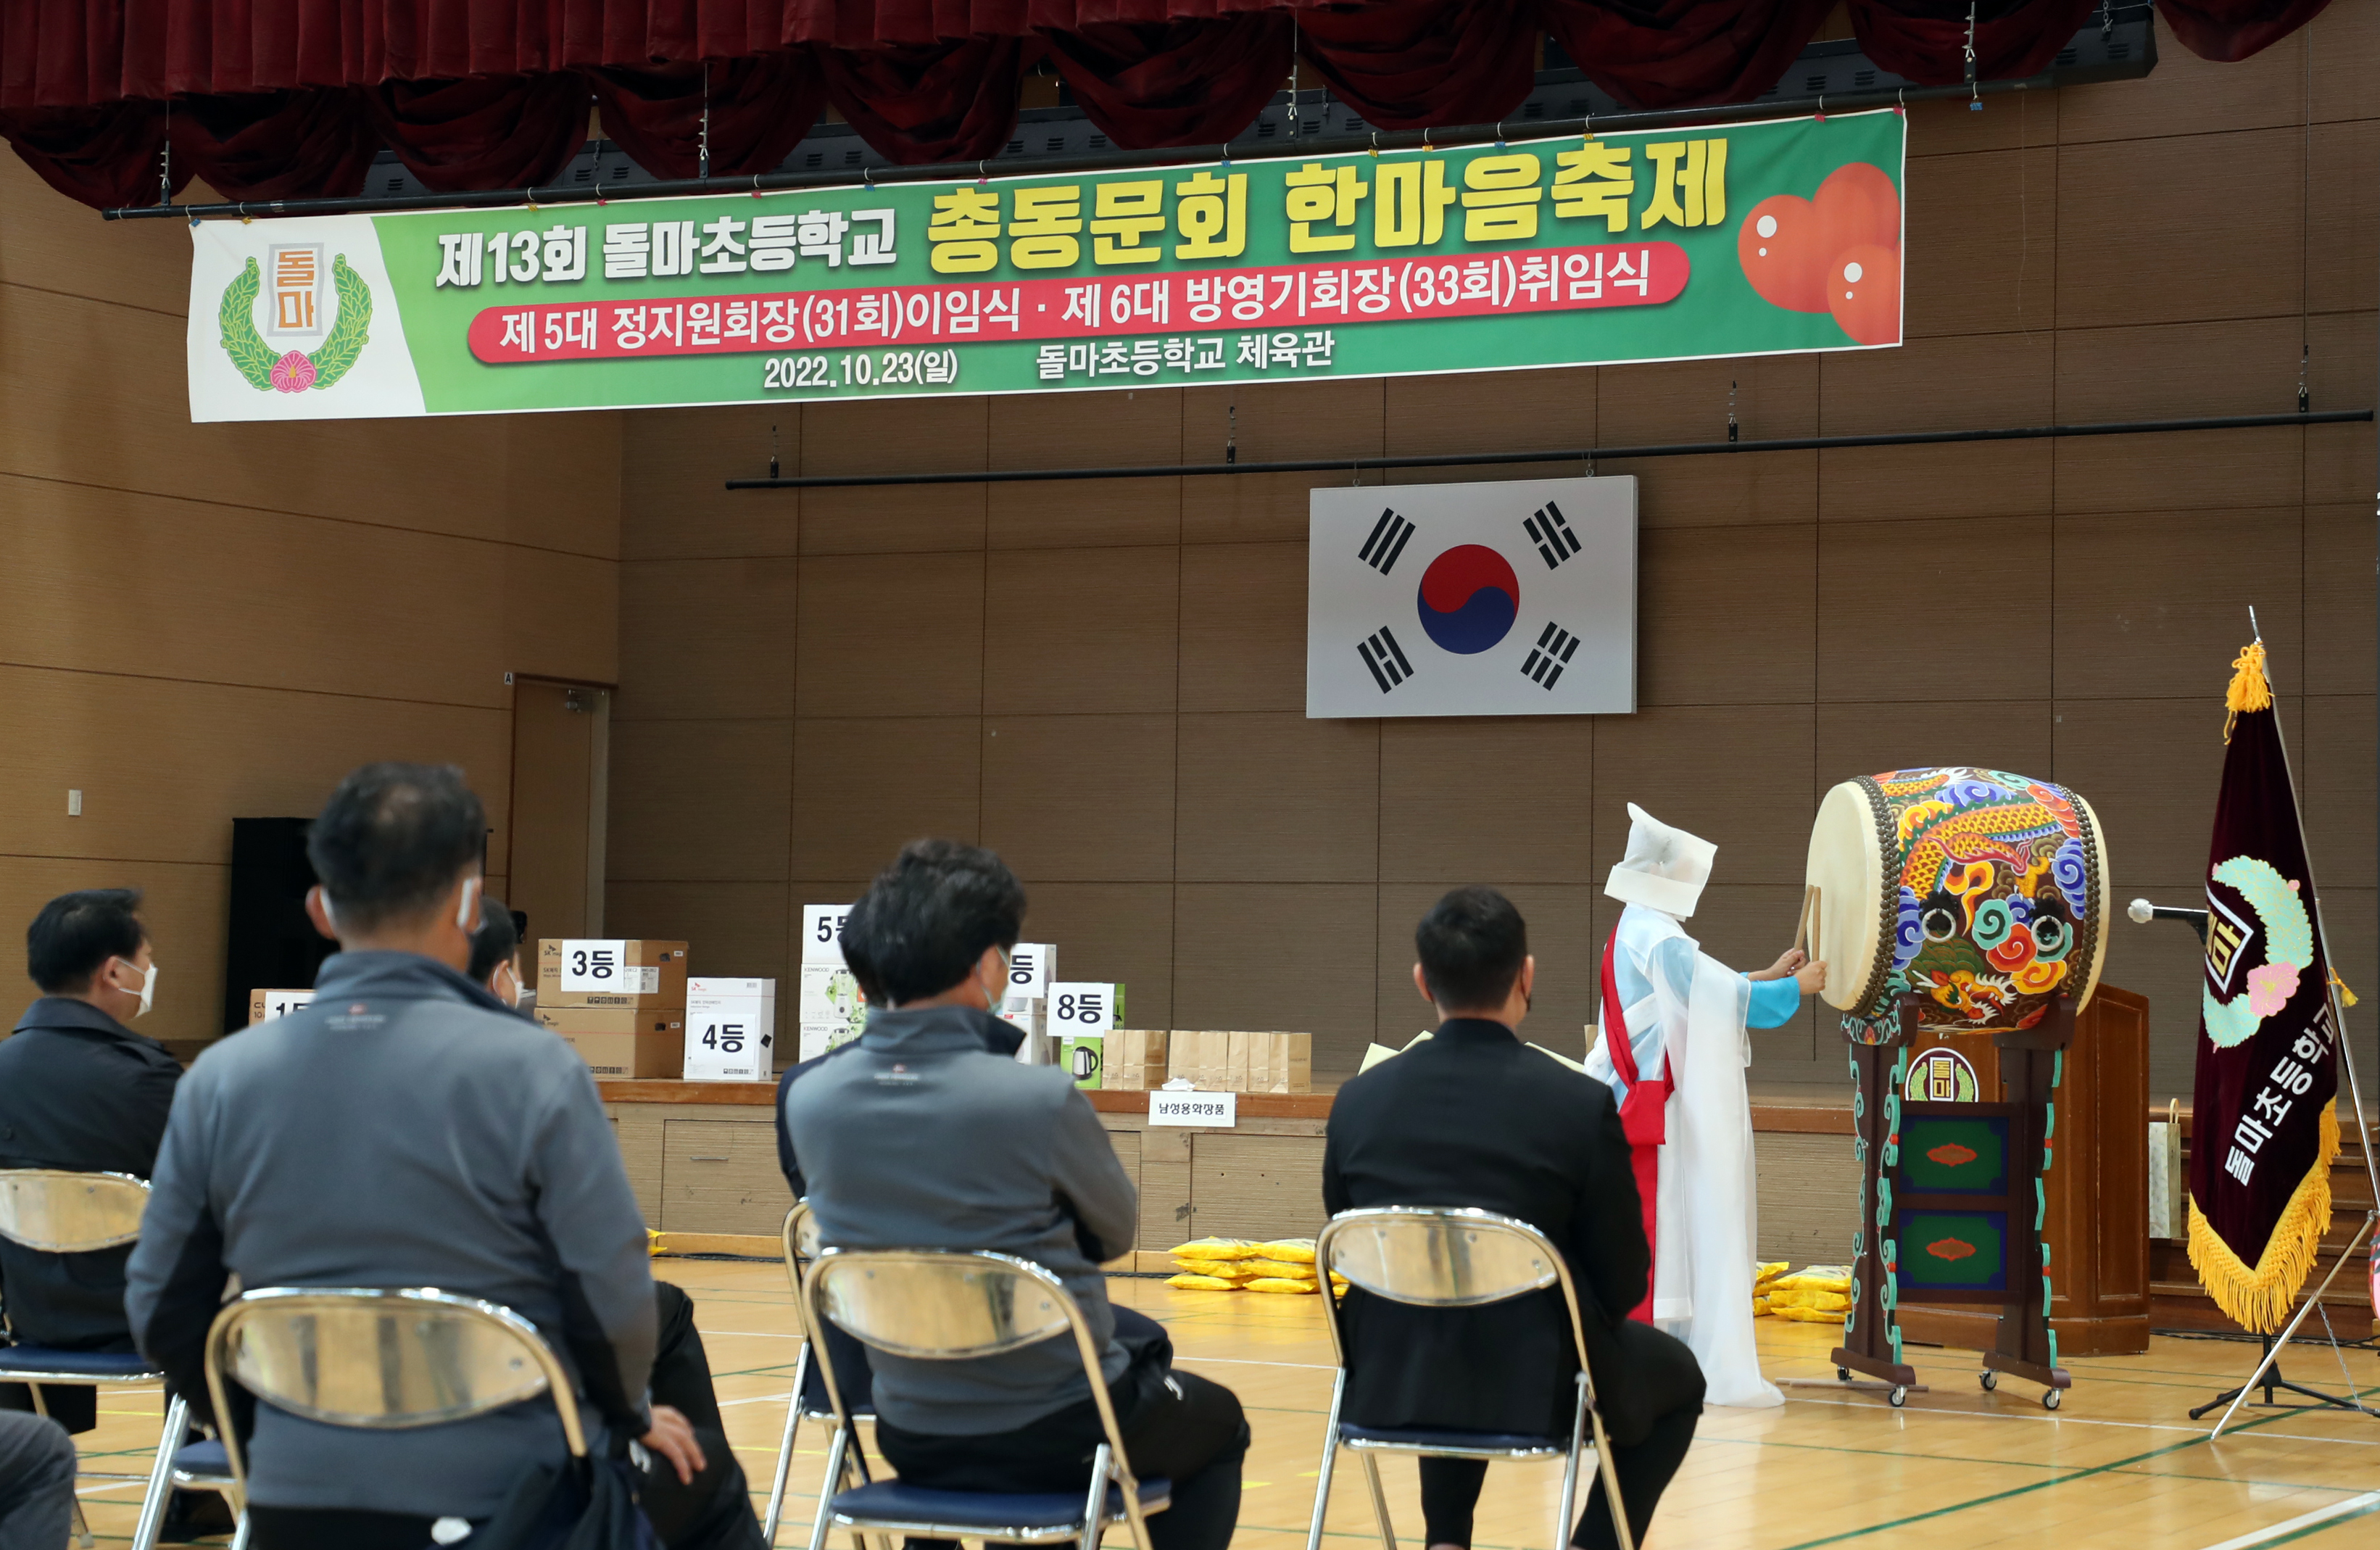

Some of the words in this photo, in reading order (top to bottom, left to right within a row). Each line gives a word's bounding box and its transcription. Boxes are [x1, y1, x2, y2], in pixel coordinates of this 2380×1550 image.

[436, 225, 586, 287] 제13회
[602, 207, 897, 280] 돌마초등학교
[928, 171, 1247, 273] 총동문회
[1285, 138, 1728, 254] 한마음축제
[611, 288, 1020, 348] 정지원회장(31회)이임식
[1186, 249, 1651, 323] 방영기회장(33회)취임식
[763, 349, 958, 389] 2022.10.23(일)
[1036, 337, 1227, 380] 돌마초등학교
[1236, 330, 1335, 370] 체육관
[572, 950, 614, 979] 3등
[1009, 955, 1034, 985] 등
[1057, 994, 1103, 1024] 8등
[702, 1024, 745, 1053] 4등
[1159, 1103, 1224, 1115] 남성용화장품
[2225, 1003, 2334, 1187] 돌마초등학교
